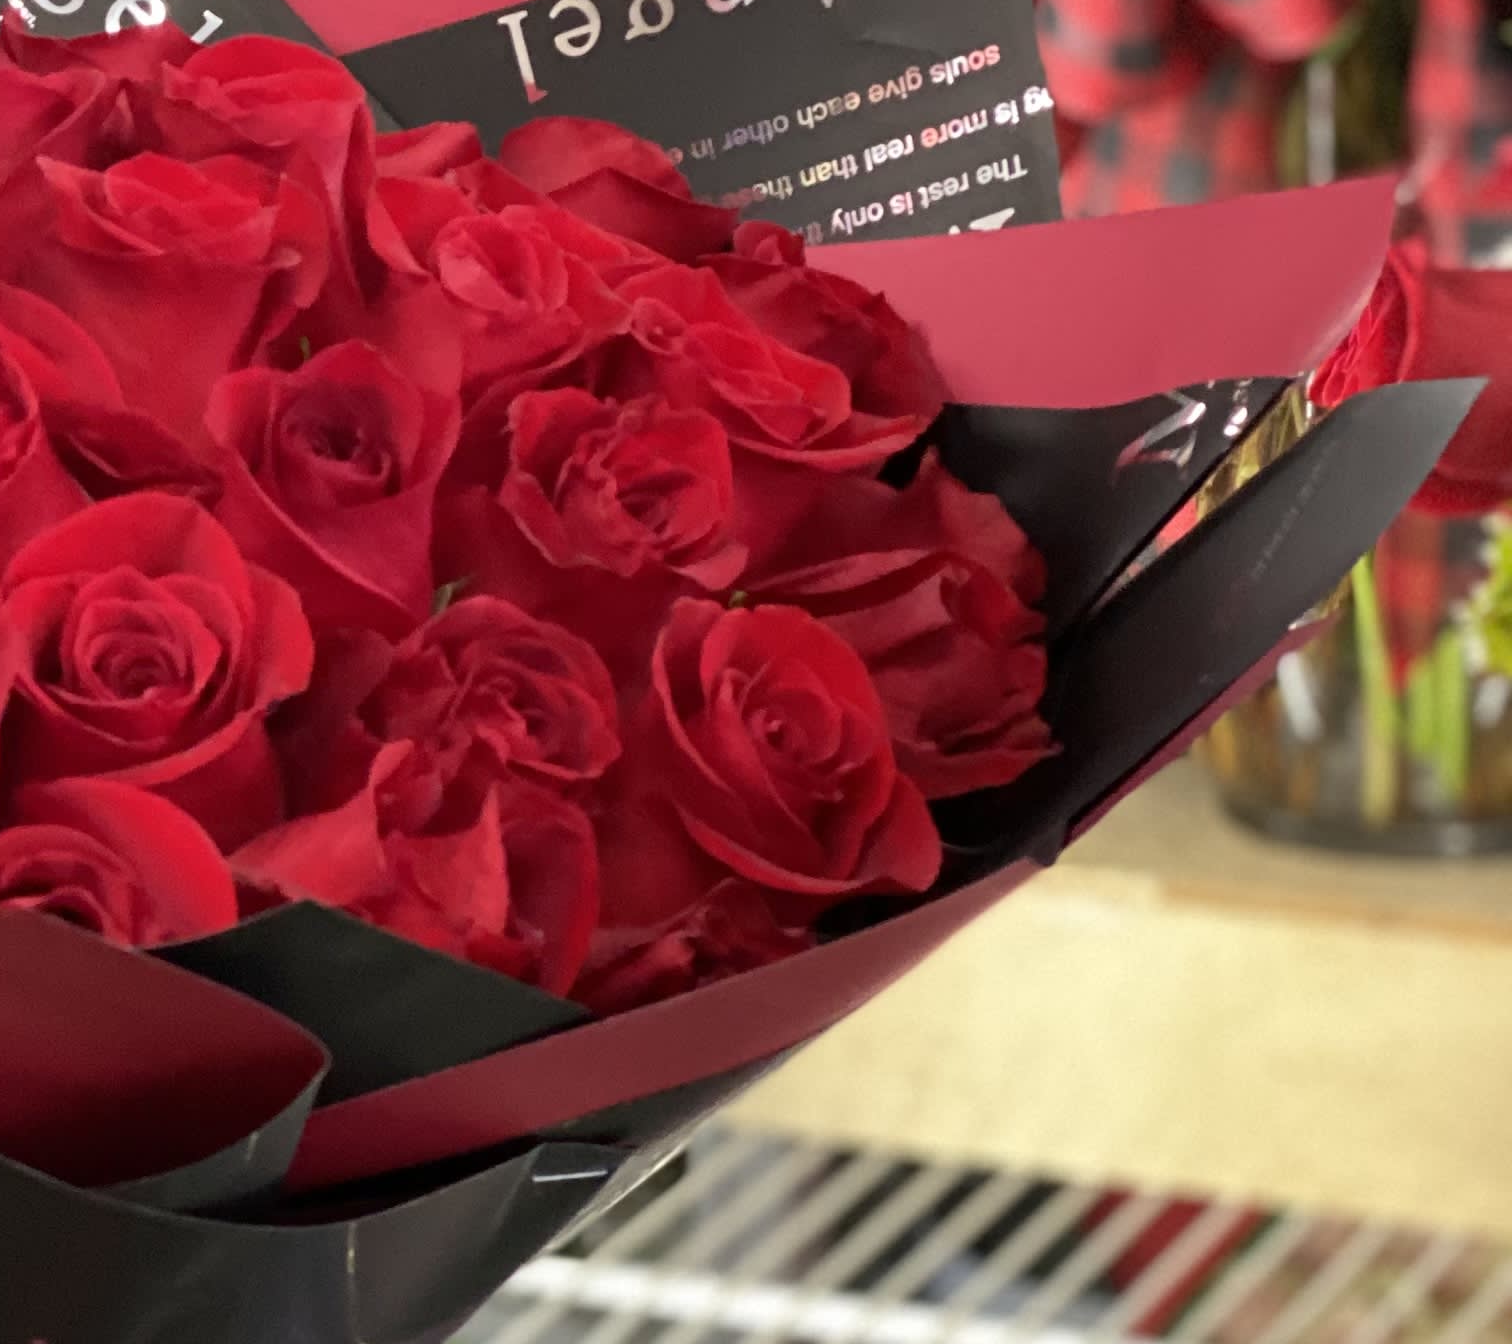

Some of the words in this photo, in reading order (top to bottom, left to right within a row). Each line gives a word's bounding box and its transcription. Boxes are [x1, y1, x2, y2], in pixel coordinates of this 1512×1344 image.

[929, 44, 1001, 85] souls
[868, 66, 923, 100] give
[796, 91, 861, 129] each
[994, 100, 1020, 125] is
[722, 115, 789, 150] other
[920, 109, 988, 148] more
[690, 137, 716, 160] in
[863, 134, 915, 172] real
[799, 154, 859, 187] than
[976, 154, 1028, 182] The
[889, 191, 914, 215] is
[918, 172, 970, 208] rest
[831, 202, 884, 235] only
